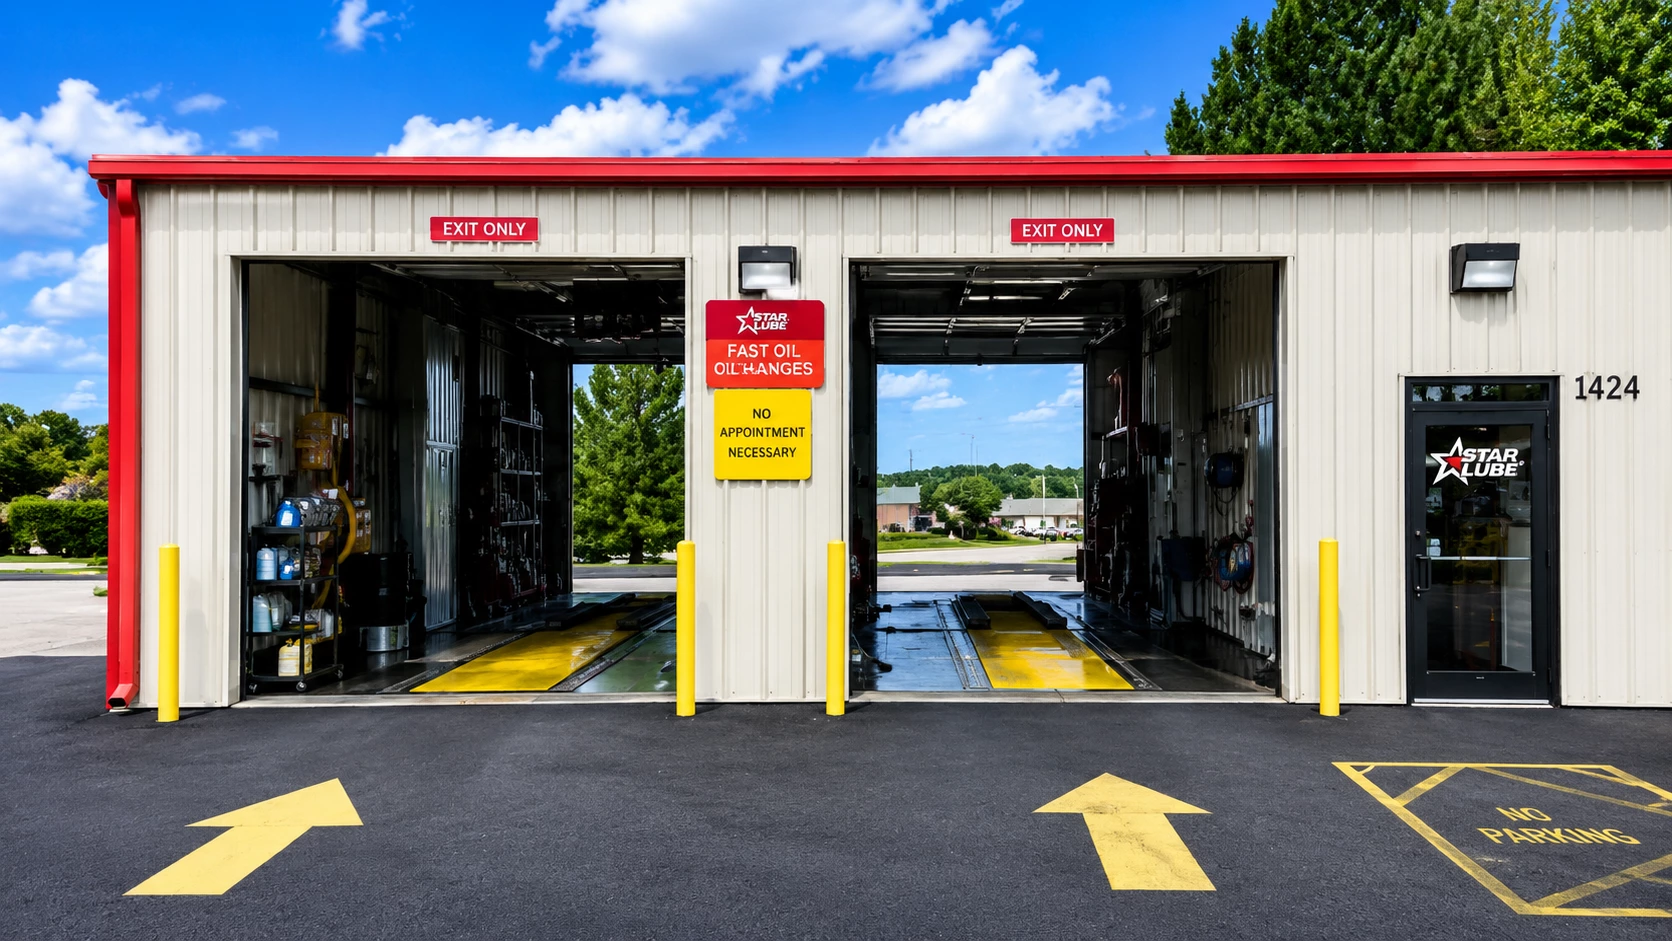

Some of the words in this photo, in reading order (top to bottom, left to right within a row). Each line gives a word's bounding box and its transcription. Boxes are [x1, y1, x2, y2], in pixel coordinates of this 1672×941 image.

[443, 221, 479, 237] EXIT
[483, 221, 526, 237] ONLY
[1022, 223, 1057, 238] EXIT
[1061, 223, 1103, 238] ONLY
[754, 312, 788, 322] STAR
[754, 321, 788, 330] LUBE
[727, 343, 770, 358] FAST
[773, 343, 801, 358] OIL
[1575, 374, 1640, 401] 1424
[752, 408, 771, 419] NO
[720, 427, 806, 438] APPOINTMENT
[728, 447, 797, 458] NECESSARY
[1461, 447, 1519, 463] STAR
[1496, 807, 1552, 822] NO
[1477, 827, 1641, 846] PARKING
